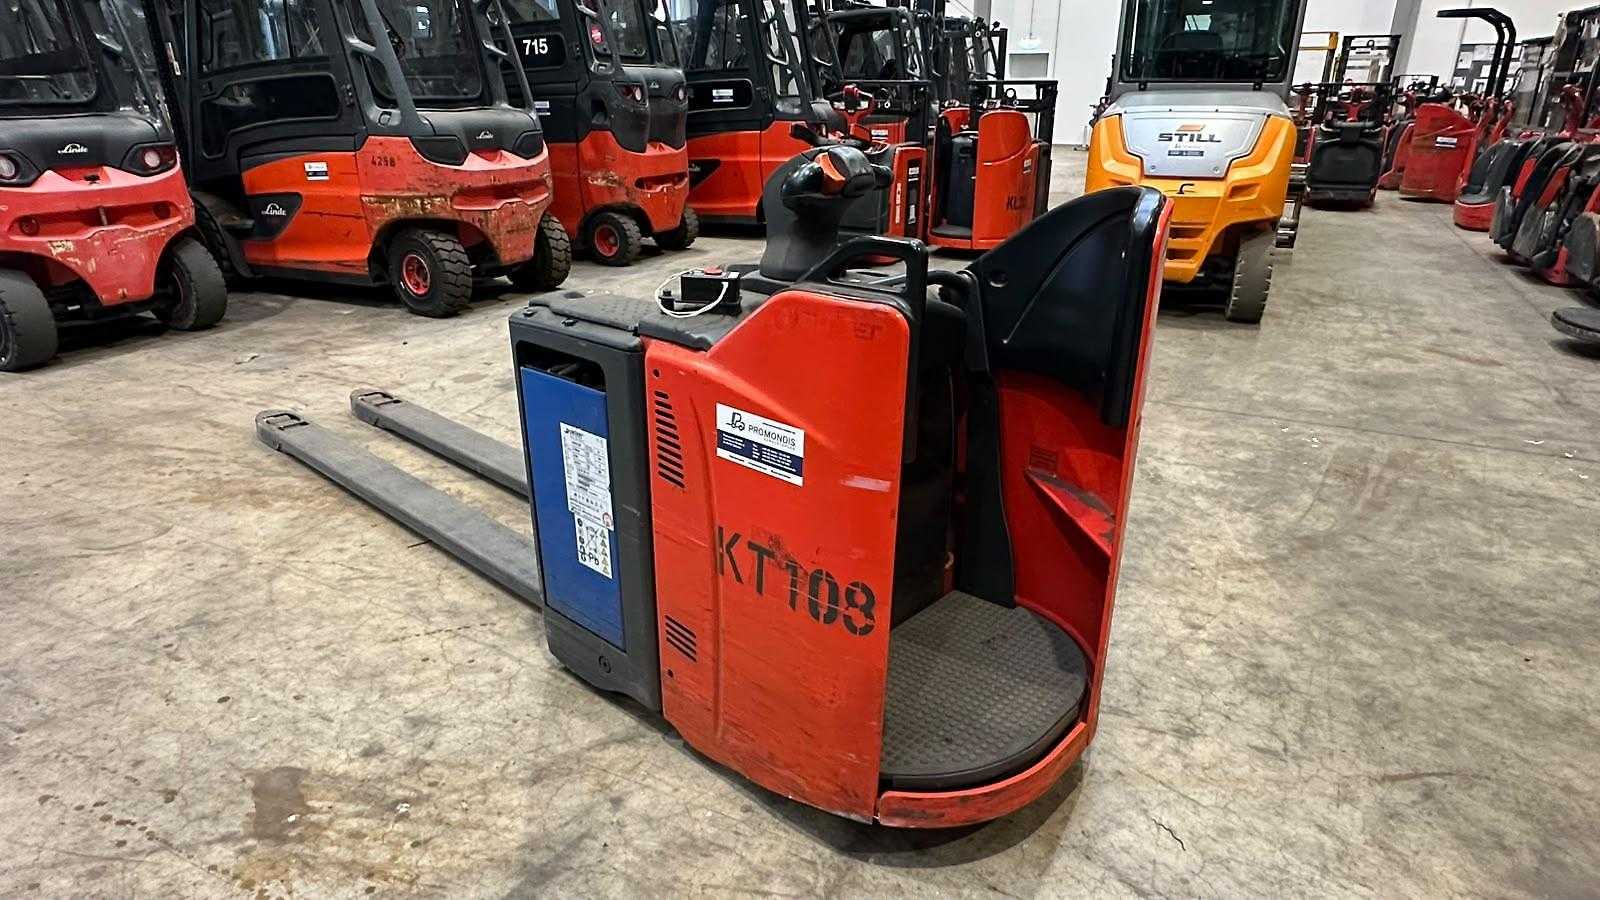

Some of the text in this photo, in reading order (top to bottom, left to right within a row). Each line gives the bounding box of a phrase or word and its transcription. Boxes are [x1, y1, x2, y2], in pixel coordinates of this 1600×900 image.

[522, 38, 548, 55] 715
[1157, 133, 1222, 143] STILL
[57, 143, 89, 154] Linde
[261, 203, 286, 216] Linde
[748, 424, 796, 447] PROMONDIS
[717, 525, 876, 637] KT108
